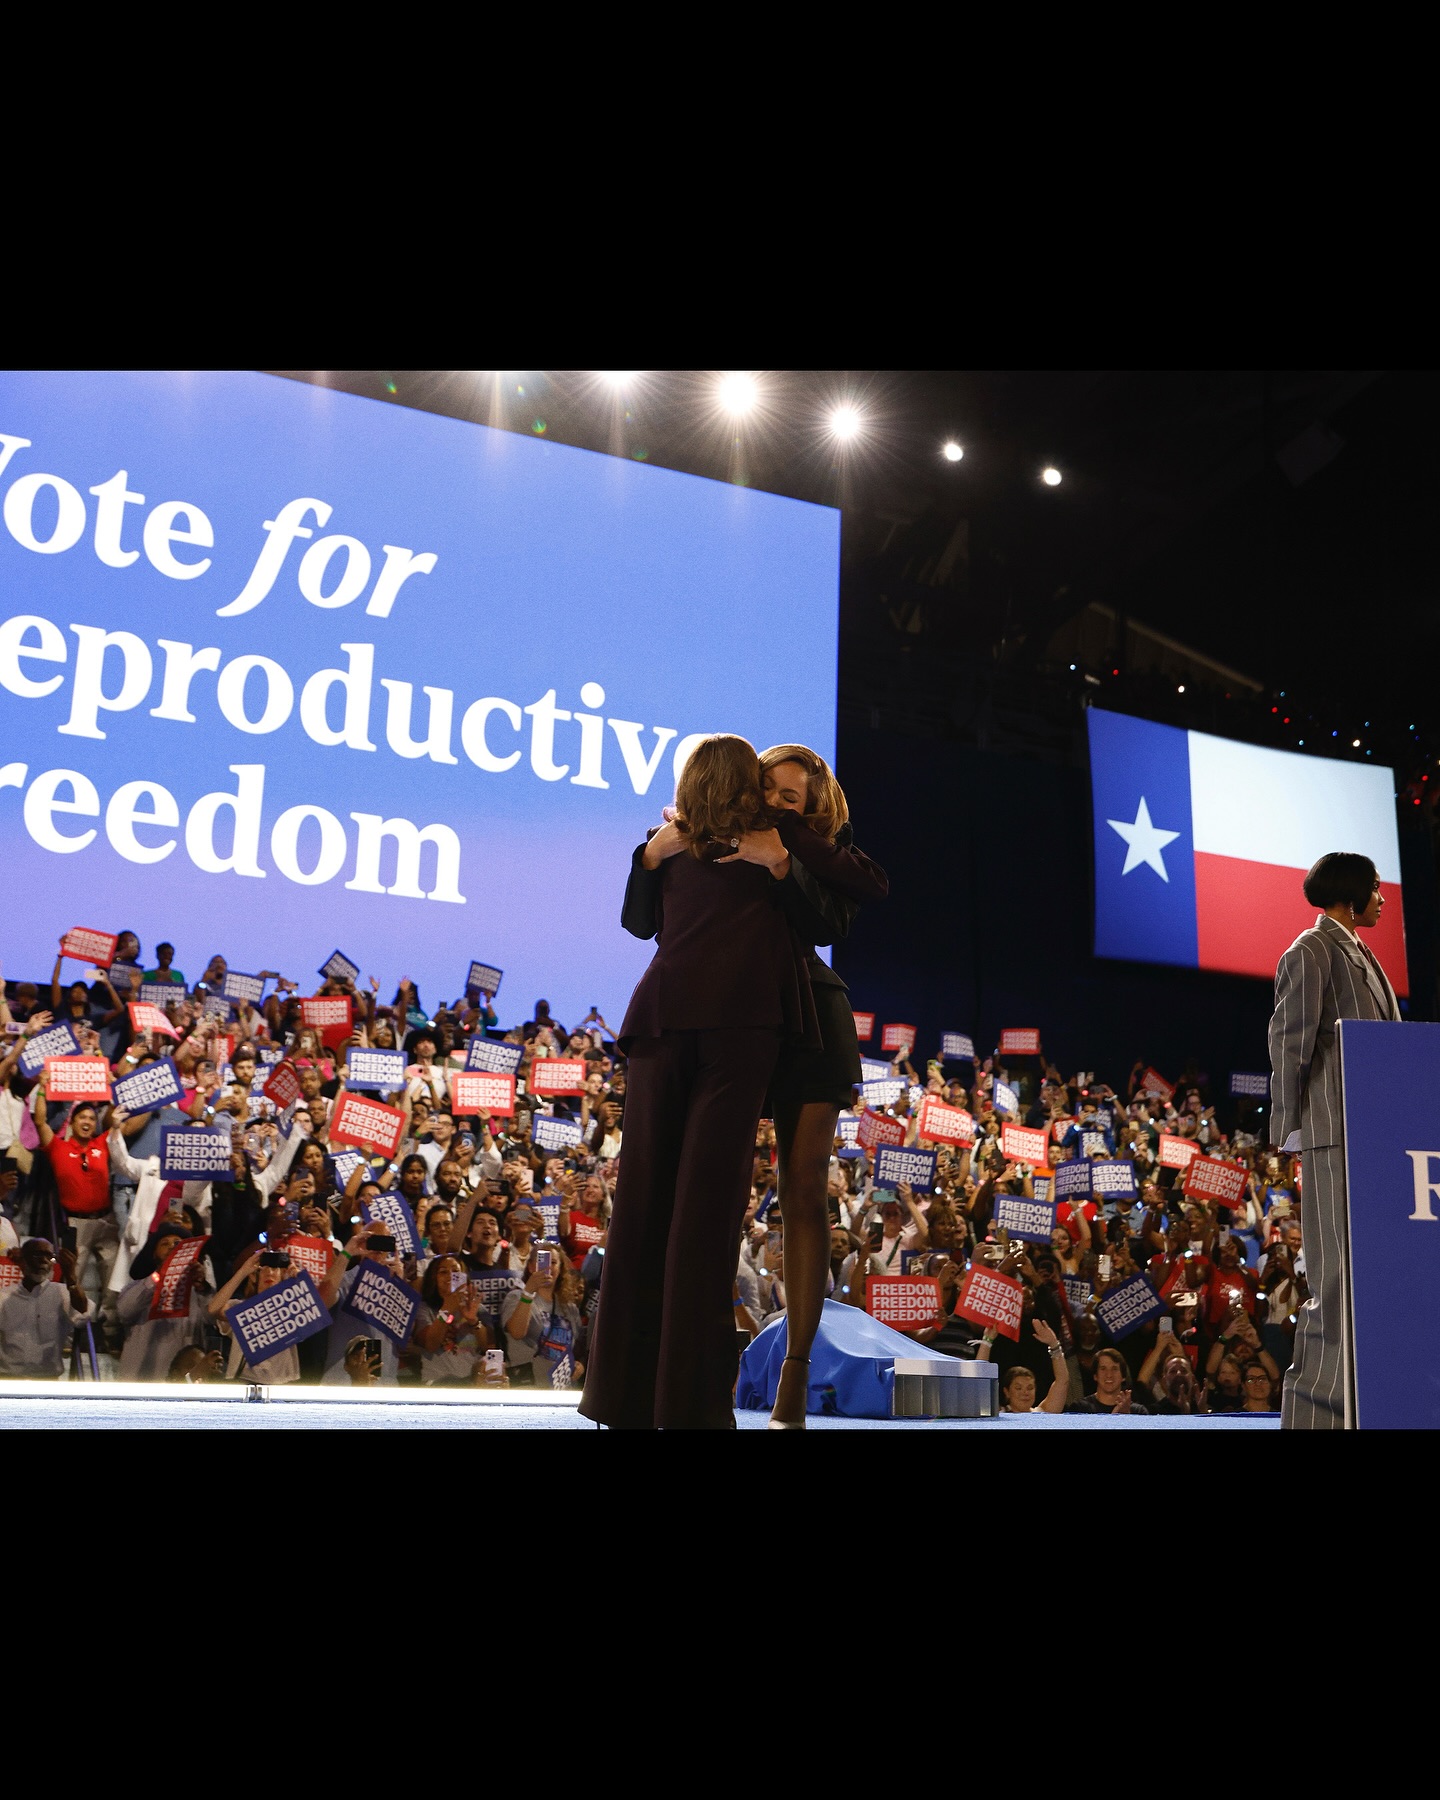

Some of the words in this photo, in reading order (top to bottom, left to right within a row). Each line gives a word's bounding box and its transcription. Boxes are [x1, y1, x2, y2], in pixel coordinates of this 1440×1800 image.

[216, 498, 438, 618] for
[0, 615, 718, 796] eproductiv
[350, 1052, 403, 1064] FREEDOM
[471, 1049, 520, 1068] FREEDOM
[472, 1040, 521, 1059] FREEDOM
[50, 1061, 106, 1072] FREEDOM
[350, 1062, 403, 1075] FREEDOM
[469, 1057, 516, 1074] FREEDOM
[536, 1062, 583, 1073] FREEDOM
[50, 1071, 106, 1082] FREEDOM
[115, 1063, 172, 1096] FREEDOM
[350, 1072, 403, 1084] FREEDOM
[457, 1077, 511, 1090] FREEDOM
[535, 1071, 583, 1081] FREEDOM
[50, 1081, 107, 1093] FREEDOM
[117, 1073, 175, 1104] FREEDOM
[457, 1087, 511, 1099] FREEDOM
[457, 1097, 511, 1109] FREEDOM
[344, 1100, 401, 1126] FREEDOM
[927, 1105, 972, 1124] FREEDOM
[341, 1110, 398, 1138] FREEDOM
[923, 1123, 971, 1141] FREEDOM
[925, 1115, 972, 1132] FREEDOM
[166, 1133, 230, 1146] FREEDOM
[337, 1120, 394, 1149] FREEDOM
[166, 1145, 230, 1159] FREEDOM
[880, 1150, 933, 1166] FREEDOM
[165, 1158, 230, 1171] FREEDOM
[879, 1160, 932, 1176] FREEDOM
[1193, 1159, 1245, 1182] FREEDOM
[1188, 1179, 1239, 1201] FREEDOM
[1191, 1170, 1242, 1192] FREEDOM
[999, 1199, 1053, 1216] FREEDOM
[998, 1209, 1052, 1226] FREEDOM
[997, 1219, 1051, 1236] FREEDOM
[361, 1270, 414, 1314] FREEDOM
[872, 1283, 937, 1296] FREEDOM
[1098, 1278, 1148, 1315] FREEDOM
[235, 1280, 310, 1327] FREEDOM
[356, 1282, 410, 1326] FREEDOM
[872, 1296, 938, 1309] FREEDOM
[1102, 1287, 1153, 1324] FREEDOM
[241, 1293, 315, 1340] FREEDOM
[351, 1295, 406, 1339] FREEDOM
[963, 1296, 1020, 1330] FREEDOM
[1108, 1296, 1160, 1334] FREEDOM
[247, 1306, 321, 1353] FREEDOM
